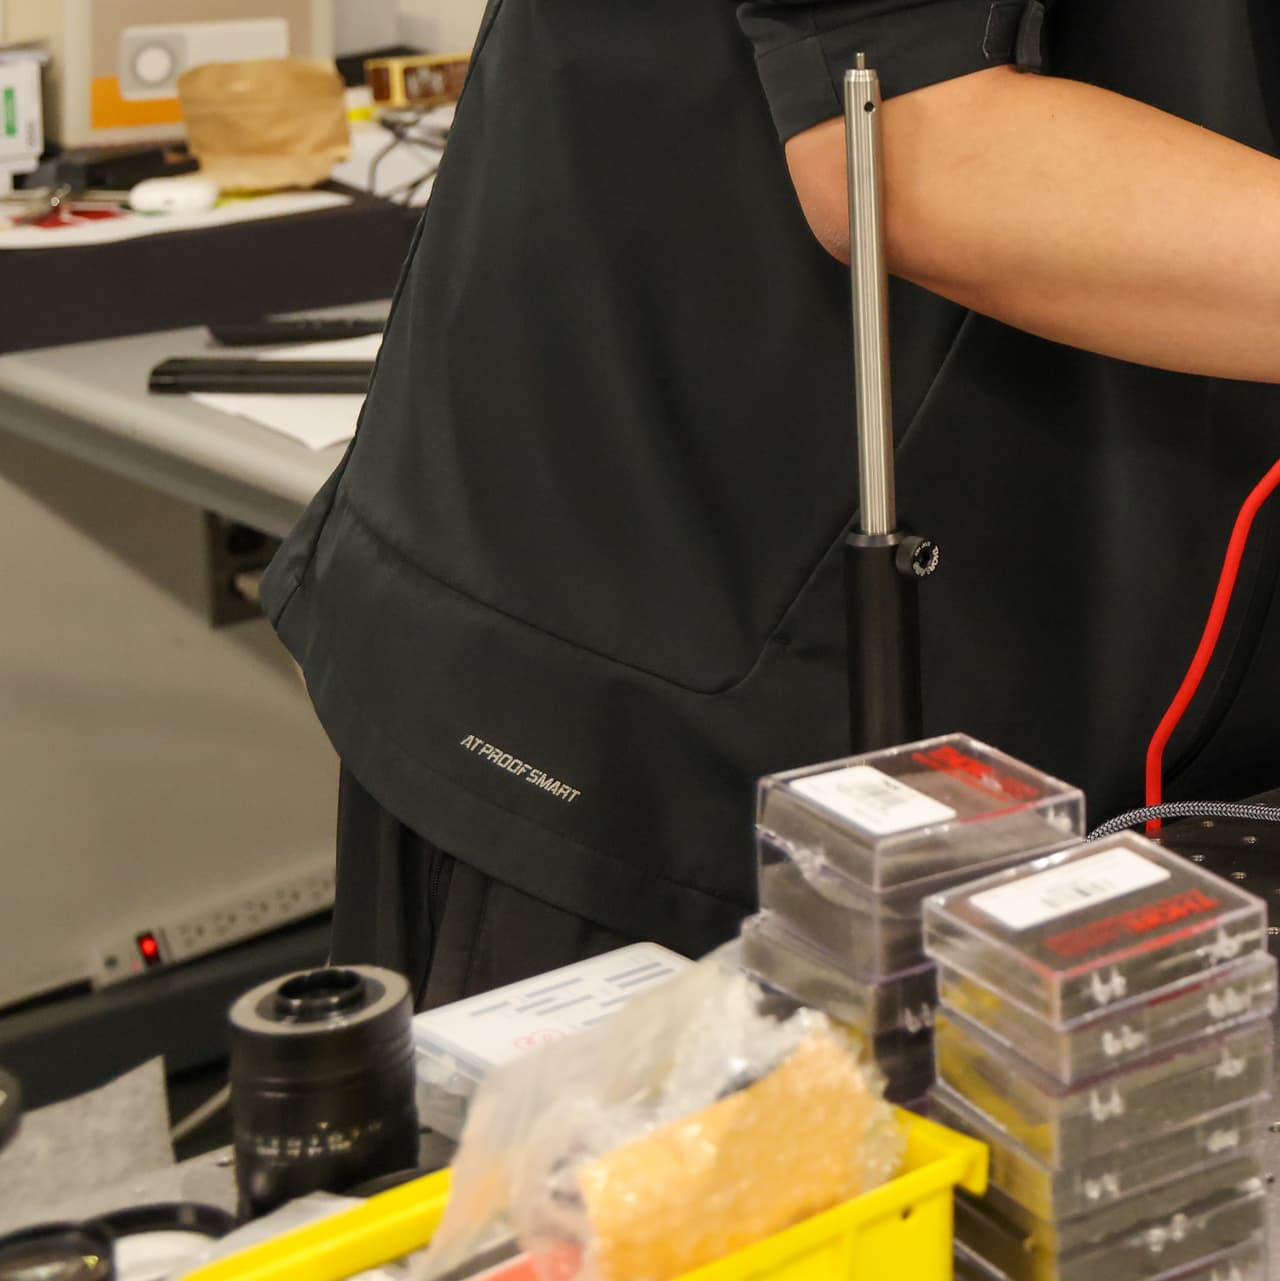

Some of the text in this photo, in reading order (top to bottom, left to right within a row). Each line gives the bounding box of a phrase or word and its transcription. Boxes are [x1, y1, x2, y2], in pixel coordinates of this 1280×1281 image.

[460, 734, 582, 803] AT PROOF SMART
